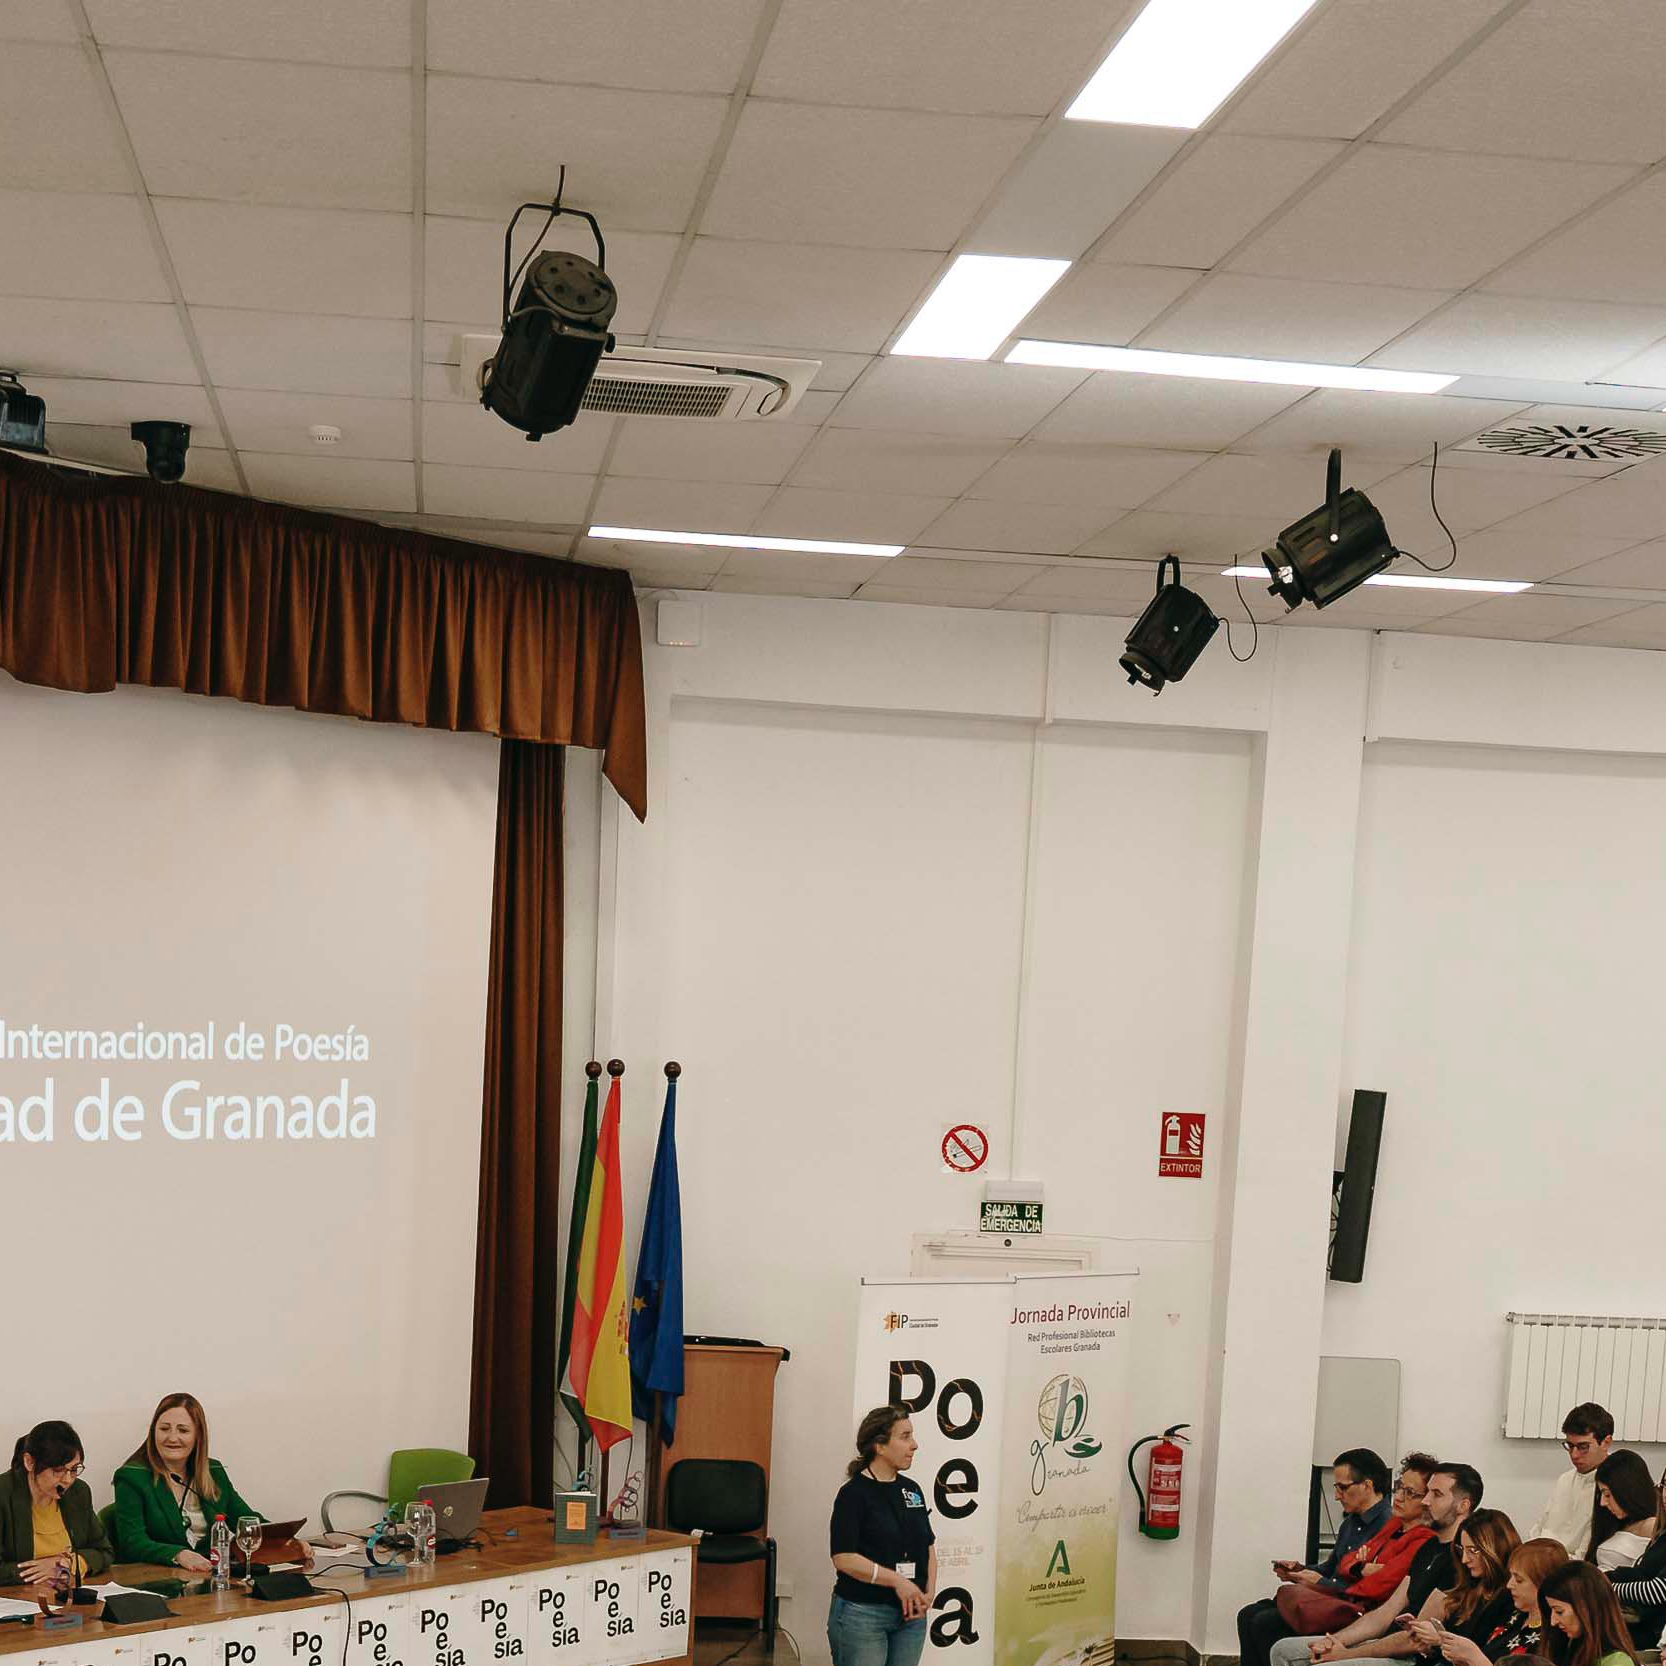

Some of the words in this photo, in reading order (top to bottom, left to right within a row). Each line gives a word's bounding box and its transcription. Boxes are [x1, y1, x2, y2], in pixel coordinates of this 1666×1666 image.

[225, 1022, 264, 1061] de
[275, 1023, 369, 1061] Poesía
[74, 1077, 144, 1142] de
[162, 1078, 376, 1141] Granada
[1160, 1162, 1201, 1173] EXTINTOR
[985, 1203, 1018, 1217] SALIDA
[1025, 1205, 1039, 1218] DE
[981, 1218, 1041, 1233] EMERGENCIA
[890, 1314, 908, 1329] FIP
[1010, 1304, 1064, 1325] Jornada
[1067, 1300, 1130, 1321] Provincial
[1028, 1332, 1041, 1343] Red
[1041, 1330, 1079, 1342] Profesional
[1080, 1329, 1116, 1339] Bibliotecas
[1040, 1343, 1072, 1354] Escolares
[1073, 1341, 1101, 1352] Granada
[889, 1360, 983, 1440] Po
[934, 1458, 979, 1519] e
[594, 1579, 620, 1602] Po
[648, 1571, 672, 1593] Po
[1029, 1583, 1046, 1592] Junta
[1048, 1581, 1056, 1589] de
[481, 1599, 507, 1622] Po
[539, 1588, 565, 1612] Po
[607, 1601, 619, 1618] e
[660, 1592, 671, 1609] e
[421, 1609, 449, 1633] Po
[552, 1610, 564, 1628] e
[607, 1612, 634, 1637] sía
[659, 1604, 687, 1628] sía
[358, 1619, 387, 1644] Po
[436, 1632, 448, 1650] e
[495, 1621, 507, 1639] e
[552, 1621, 580, 1647] sía
[224, 1641, 256, 1666] Po
[292, 1631, 323, 1656] Po
[374, 1643, 387, 1661] e
[494, 1634, 524, 1659] sía
